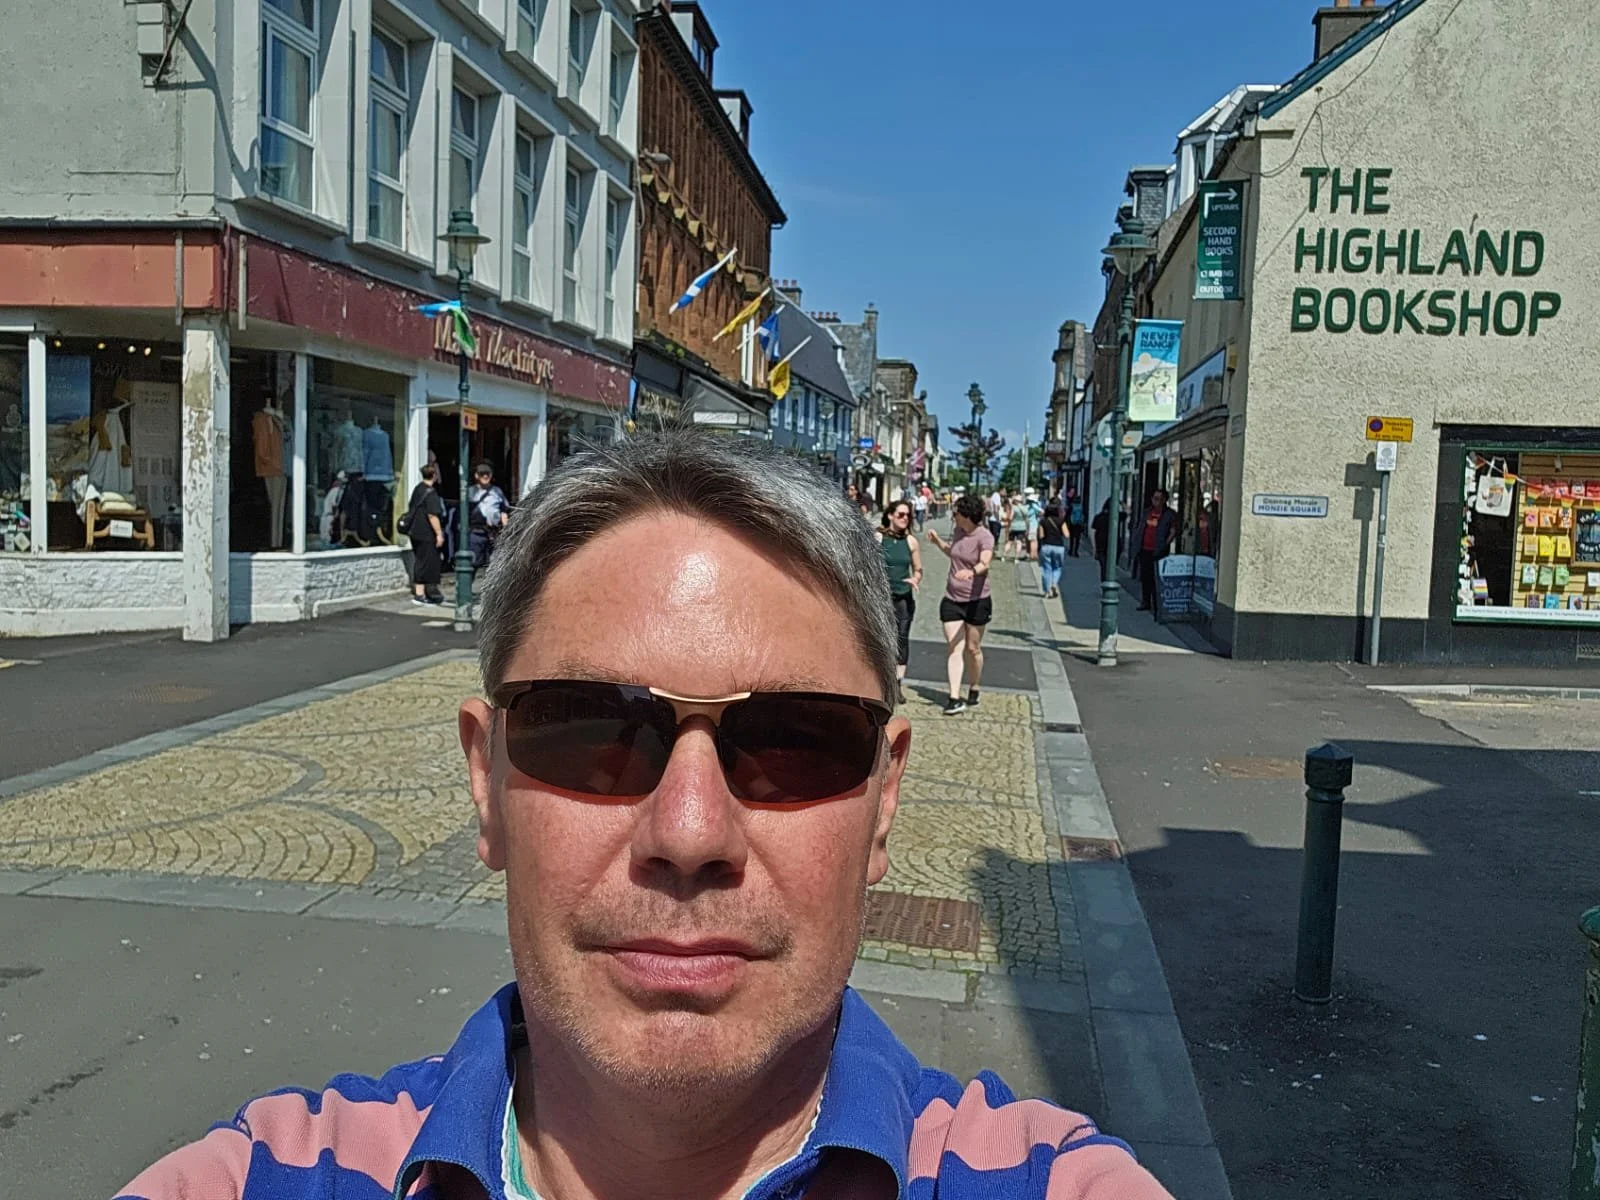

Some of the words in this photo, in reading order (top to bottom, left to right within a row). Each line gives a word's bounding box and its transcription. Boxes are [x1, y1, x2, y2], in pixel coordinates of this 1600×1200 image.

[1300, 167, 1393, 214] THE
[1203, 226, 1237, 236] SECOND
[1207, 236, 1233, 247] HAND
[1205, 246, 1234, 256] BOOKS
[1294, 228, 1545, 276] HIGHLAND
[1291, 287, 1562, 336] BOOKSHOP
[1141, 331, 1179, 341] NEVIS
